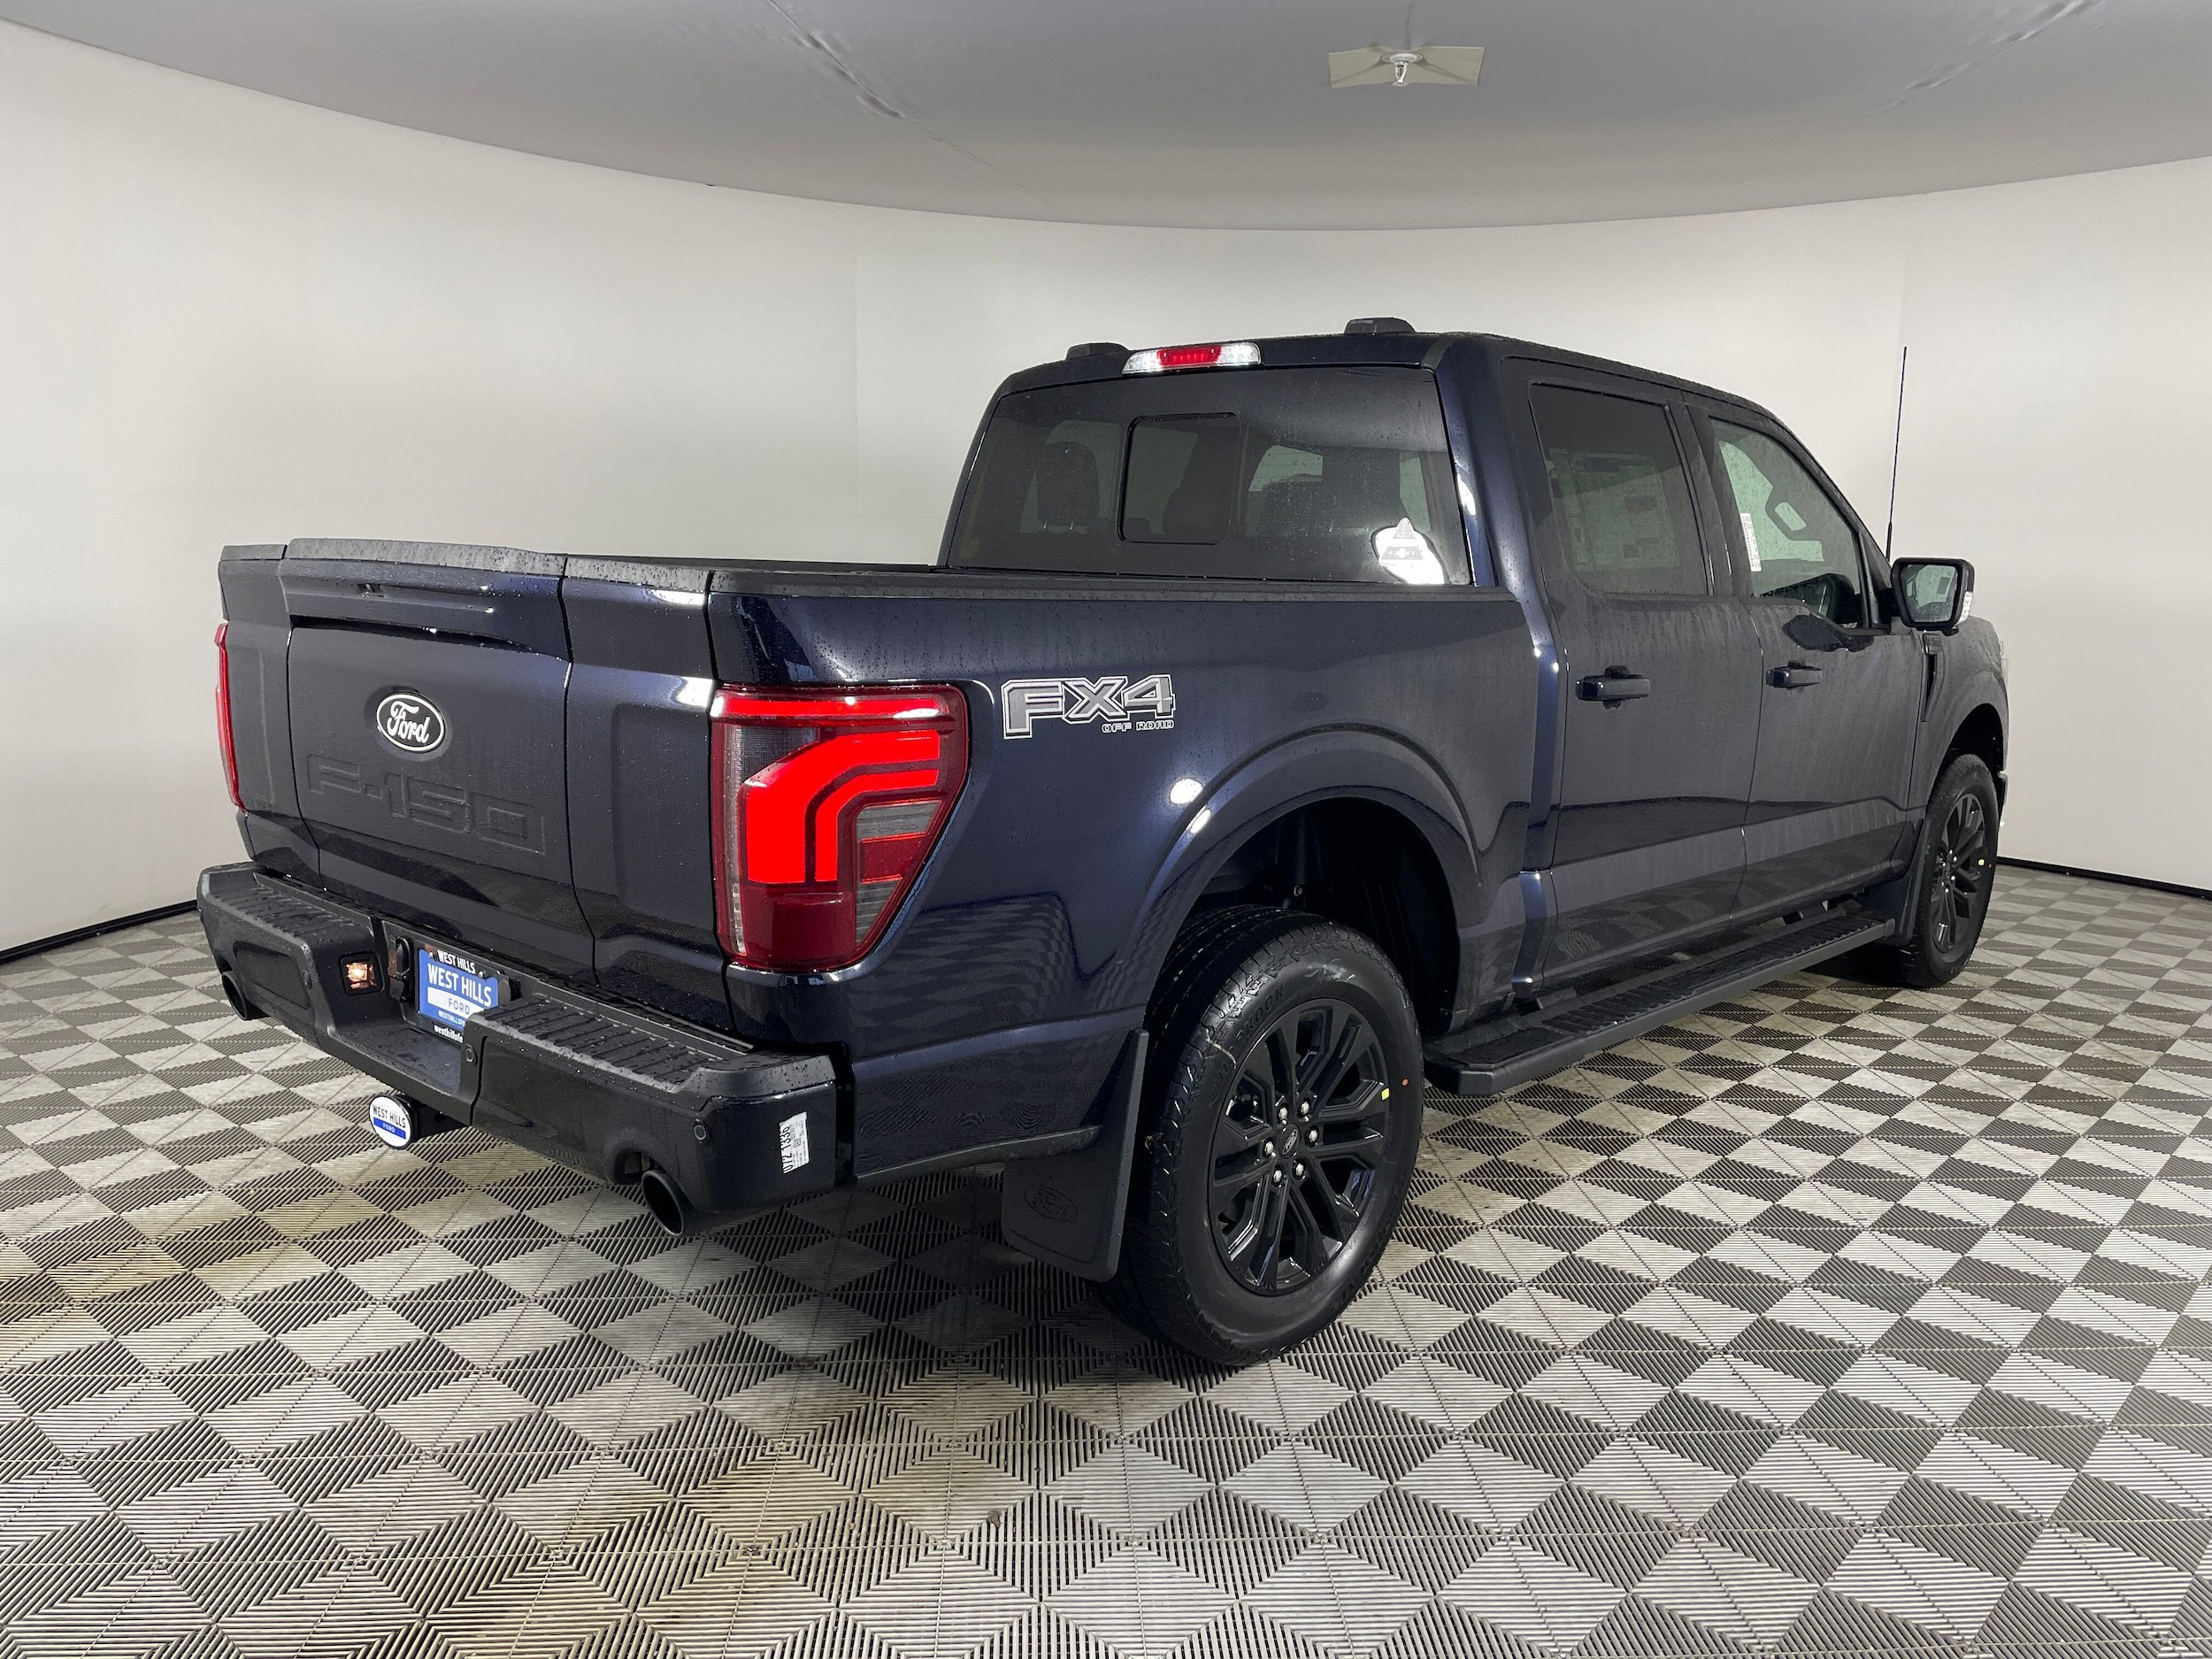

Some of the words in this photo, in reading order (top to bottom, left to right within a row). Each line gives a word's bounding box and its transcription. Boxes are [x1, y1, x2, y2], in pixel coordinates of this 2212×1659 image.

[1001, 674, 1176, 740] FX4
[387, 700, 431, 744] Ford
[1102, 723, 1133, 733] OFF
[1136, 719, 1175, 731] ROAD
[306, 754, 547, 856] F-150
[437, 949, 457, 969] WEST
[456, 955, 476, 974] HILLS
[427, 963, 458, 992] WEST
[461, 976, 492, 1008] HILLS
[448, 998, 471, 1015] FORD
[372, 1103, 388, 1118] WEST
[389, 1111, 406, 1128] HILLS
[382, 1122, 396, 1133] FORD
